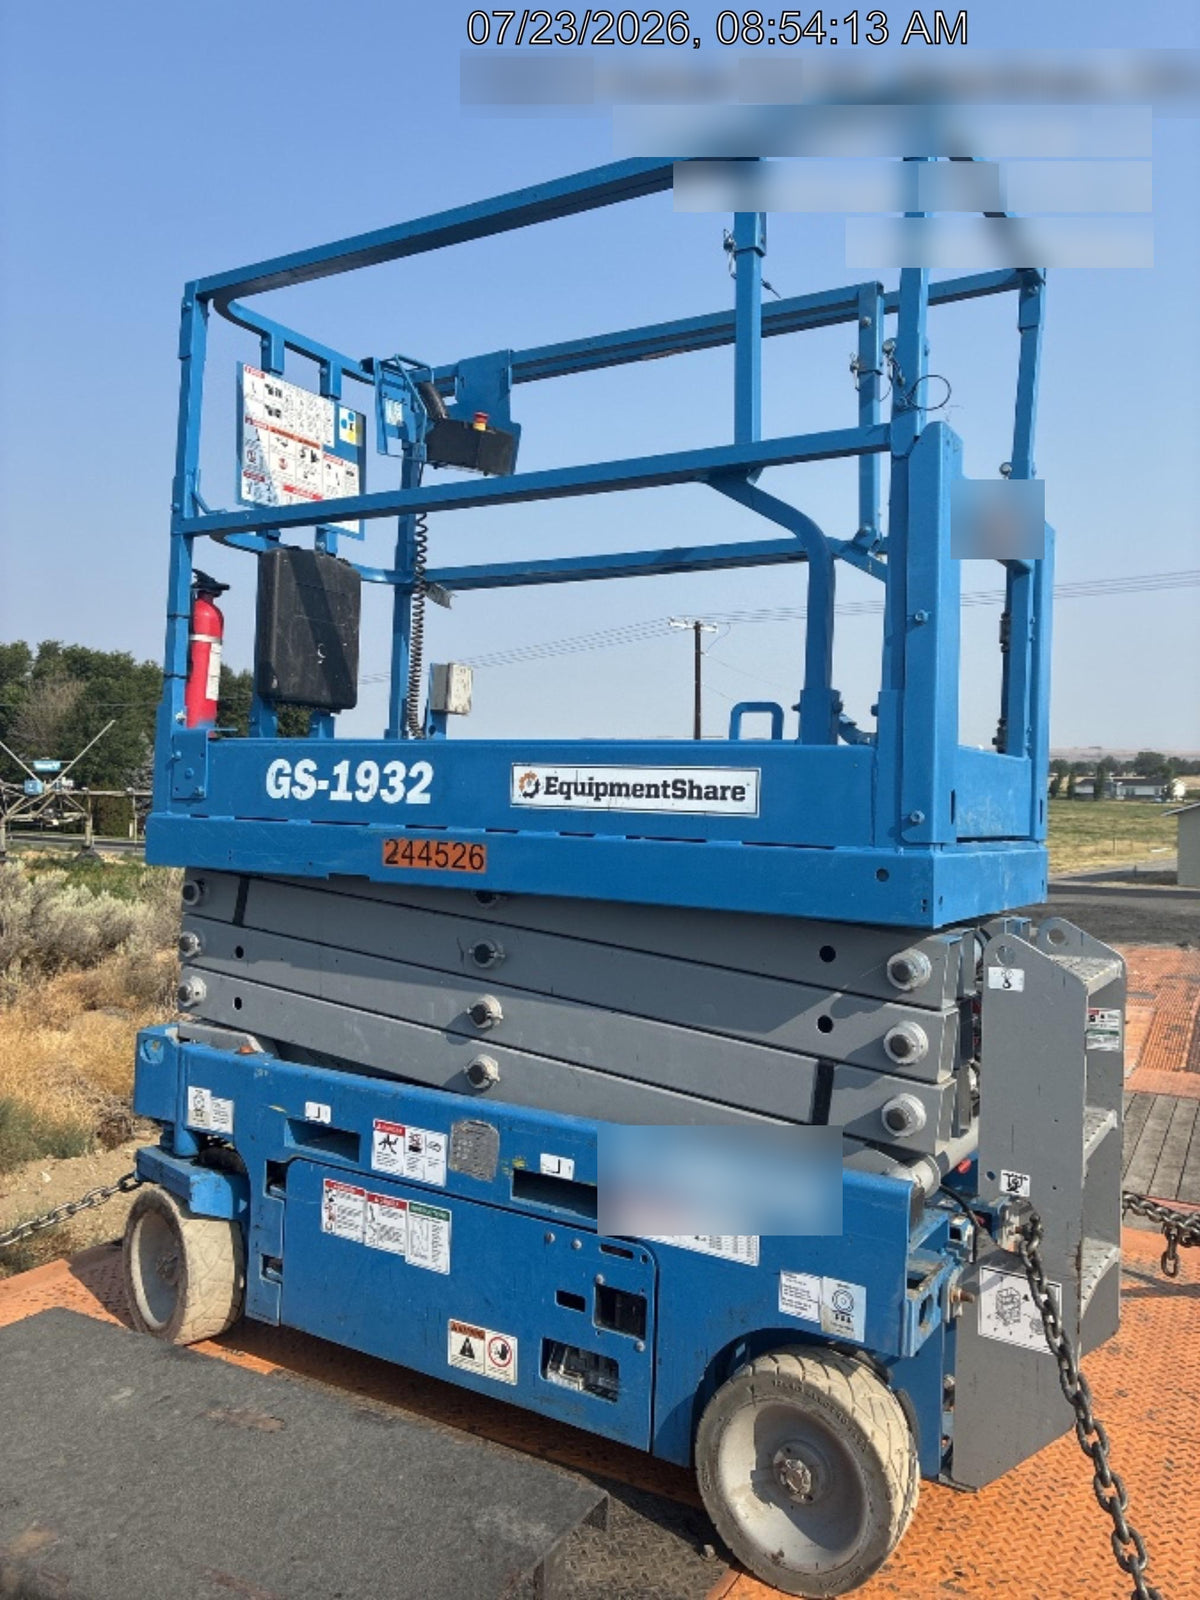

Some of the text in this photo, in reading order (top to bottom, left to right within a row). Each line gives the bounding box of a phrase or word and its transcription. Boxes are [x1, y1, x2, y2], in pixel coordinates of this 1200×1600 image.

[265, 758, 434, 805] GS-1932
[543, 776, 746, 802] EquipmentShare
[384, 838, 485, 871] 244526
